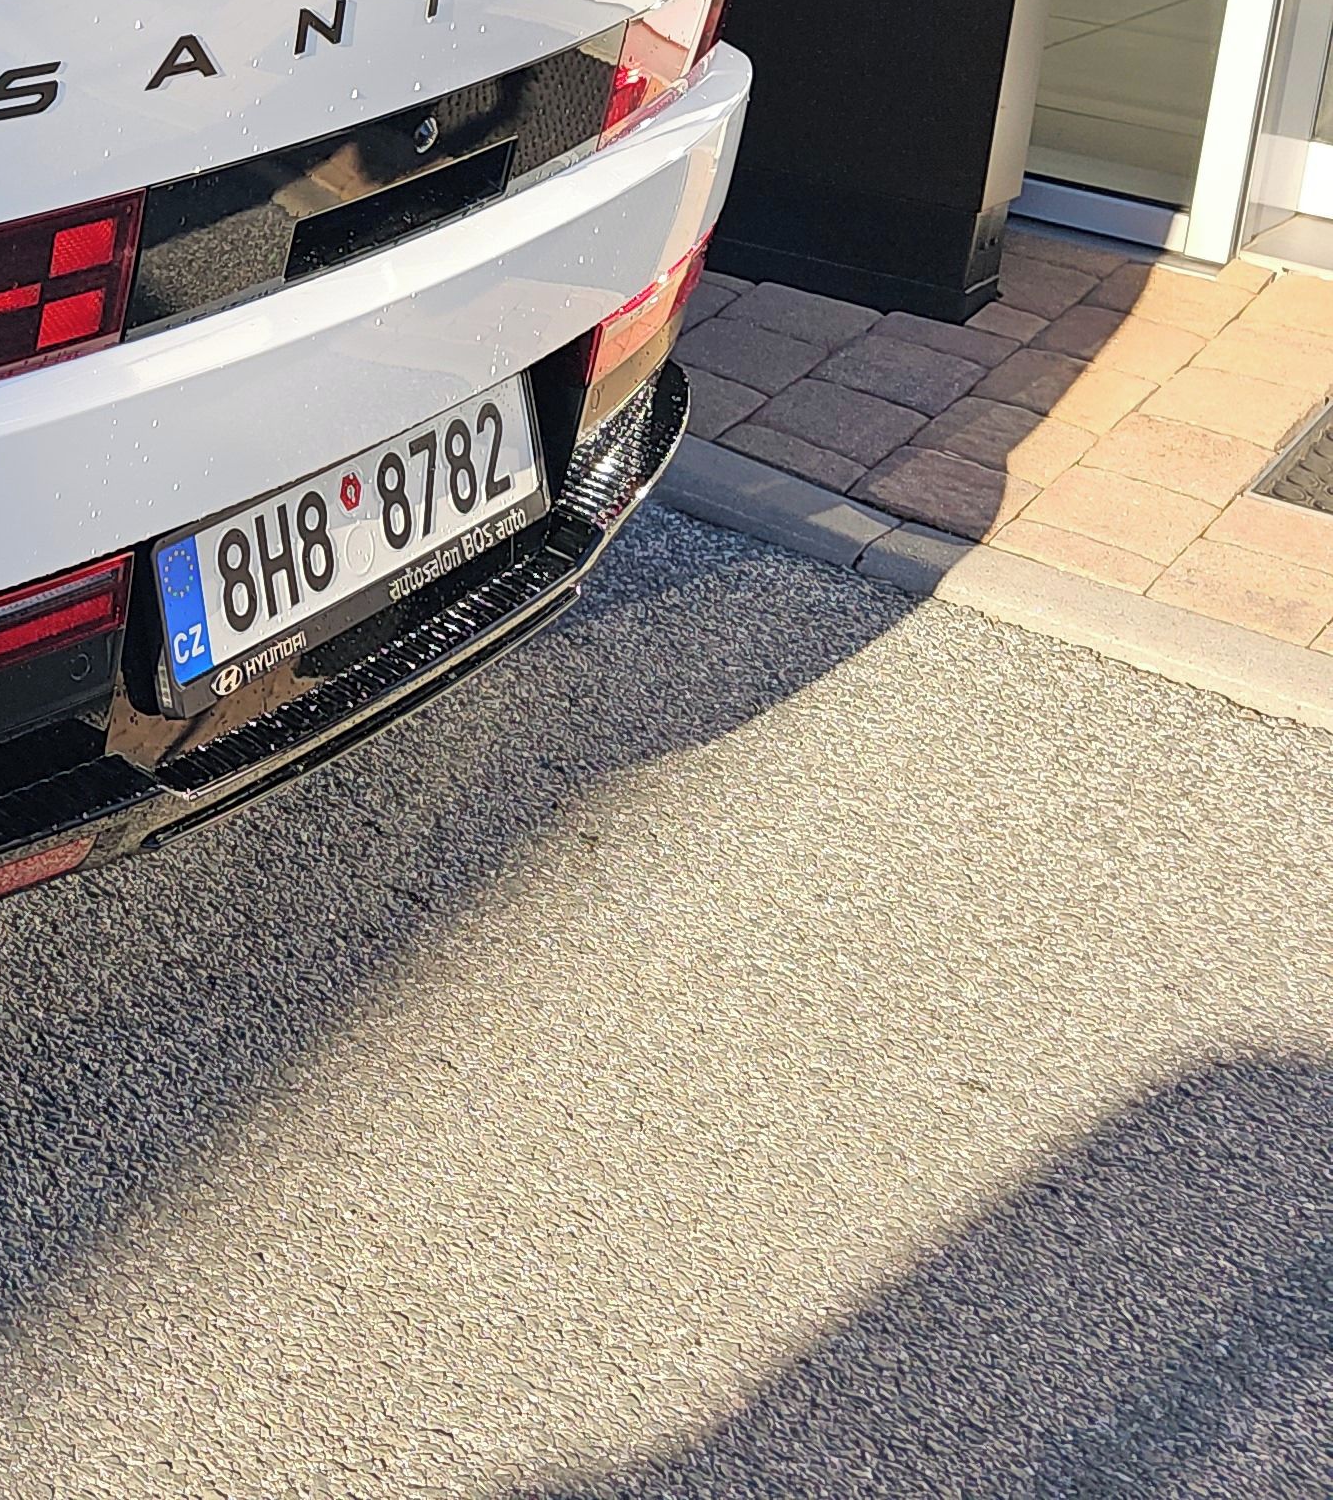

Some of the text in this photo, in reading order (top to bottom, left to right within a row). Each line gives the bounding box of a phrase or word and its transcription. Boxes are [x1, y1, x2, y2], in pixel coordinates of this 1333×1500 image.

[218, 402, 512, 633] 8H8 8782
[388, 506, 527, 604] autosalon BOS auto
[173, 623, 205, 664] CZ
[244, 631, 307, 683] HYUNDAI
